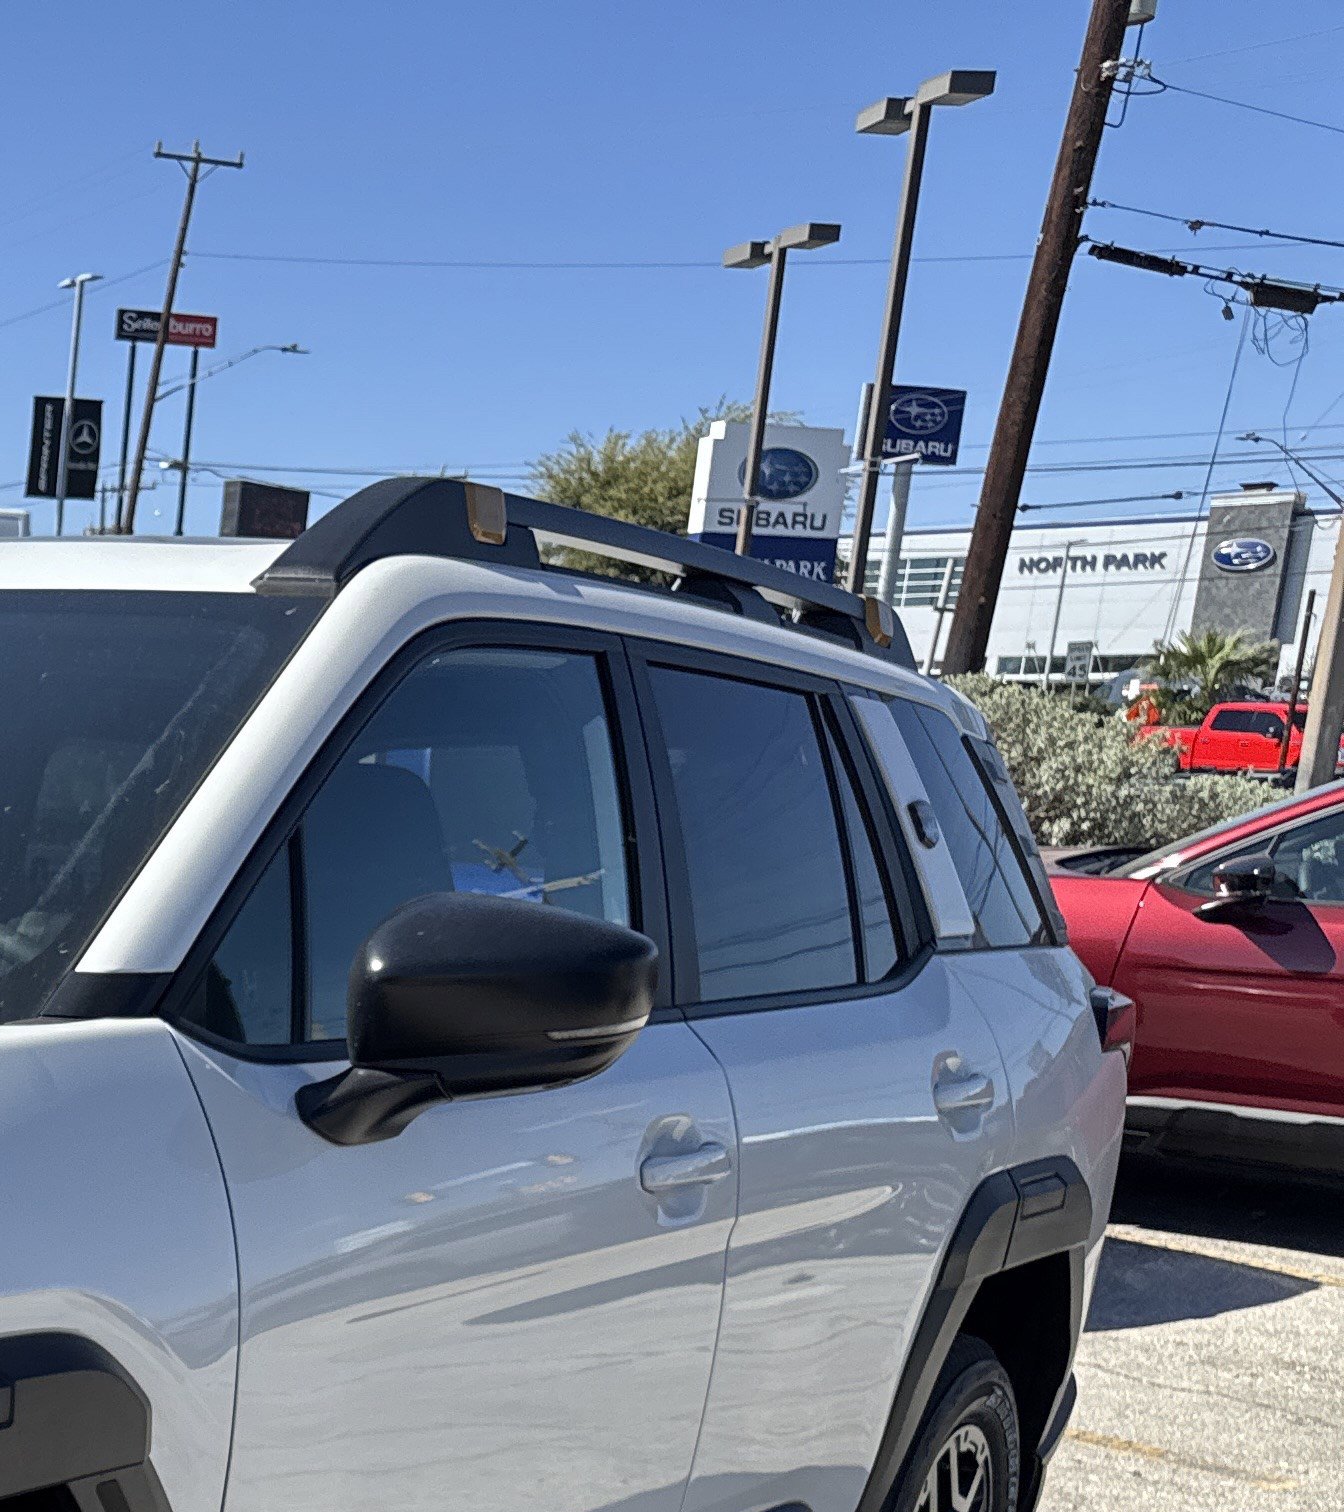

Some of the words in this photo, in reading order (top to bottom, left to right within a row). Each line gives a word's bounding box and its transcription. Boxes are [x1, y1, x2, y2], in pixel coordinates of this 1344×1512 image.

[717, 507, 827, 531] SBARU
[1018, 554, 1098, 575] NORTH
[1103, 551, 1168, 572] PARK
[1067, 663, 1087, 678] 45
